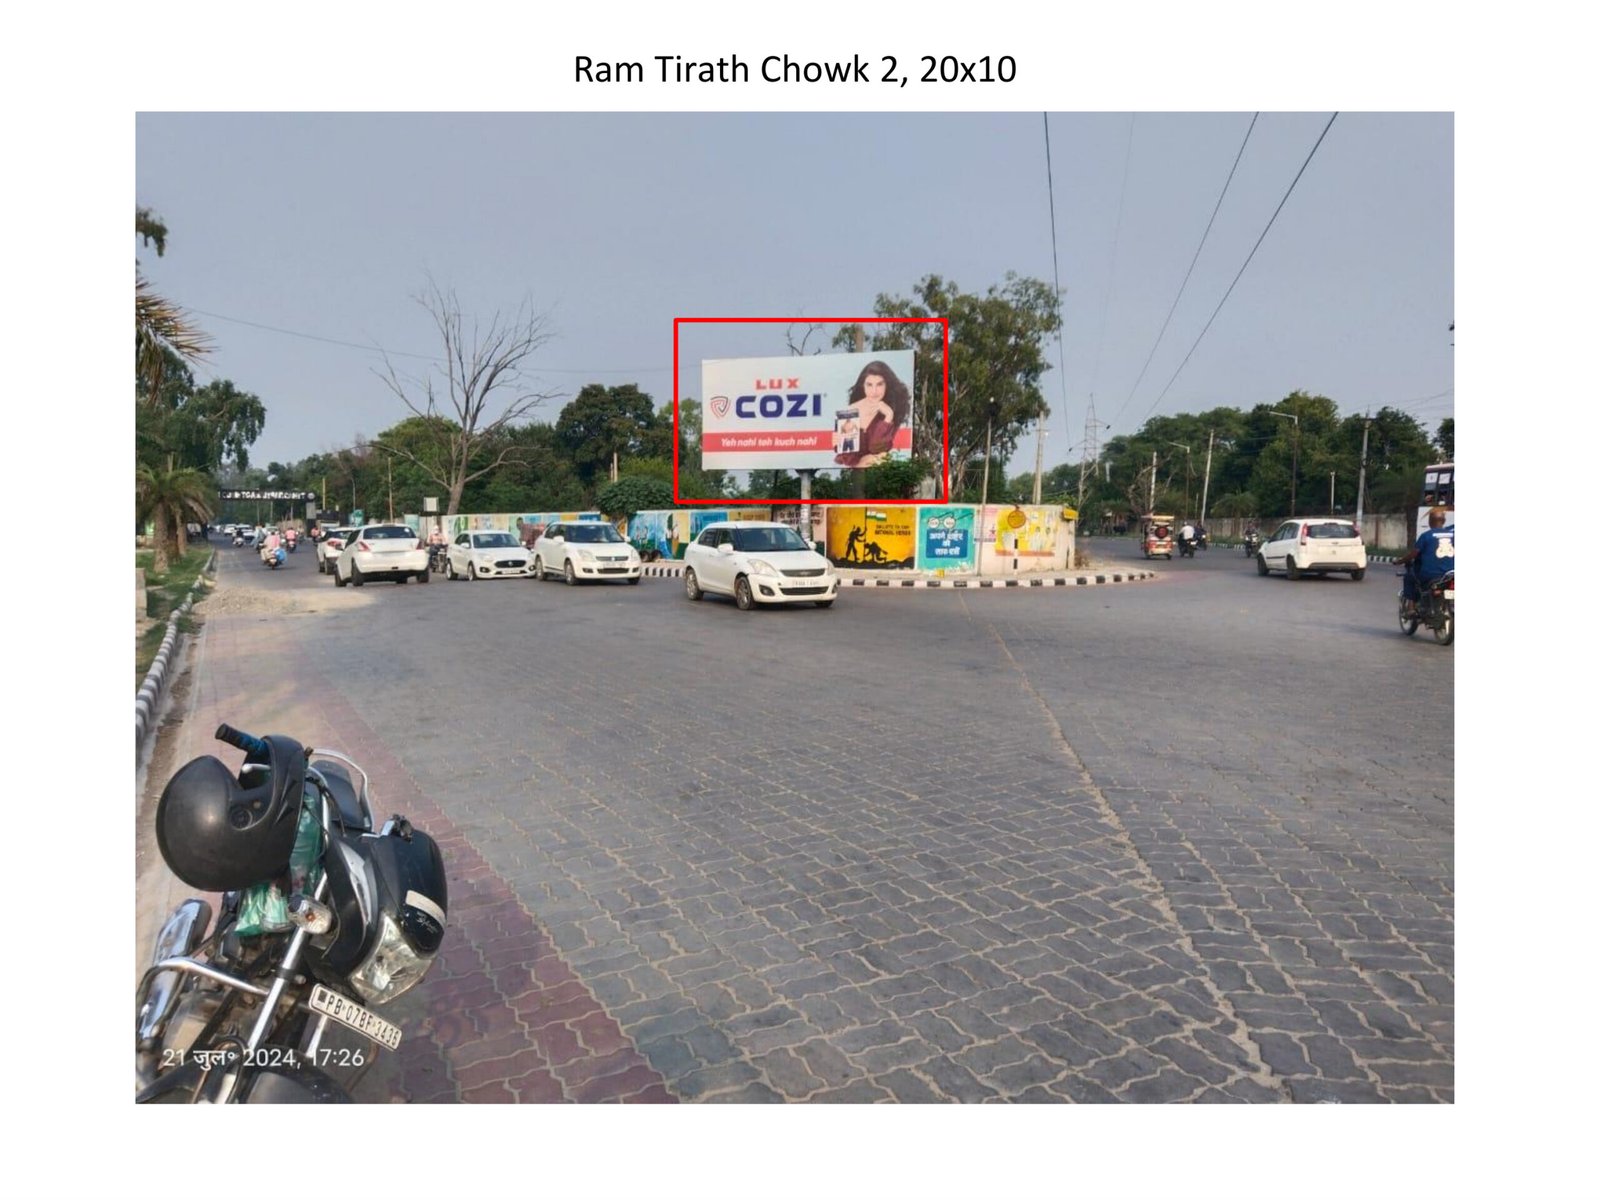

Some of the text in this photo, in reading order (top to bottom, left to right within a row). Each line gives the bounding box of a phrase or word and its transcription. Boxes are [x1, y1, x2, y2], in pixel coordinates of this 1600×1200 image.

[755, 378, 800, 390] LUX
[736, 393, 822, 419] COZI
[721, 437, 737, 447] Yeh
[737, 437, 757, 447] nahi
[774, 436, 796, 446] kuch
[797, 435, 818, 446] nahi
